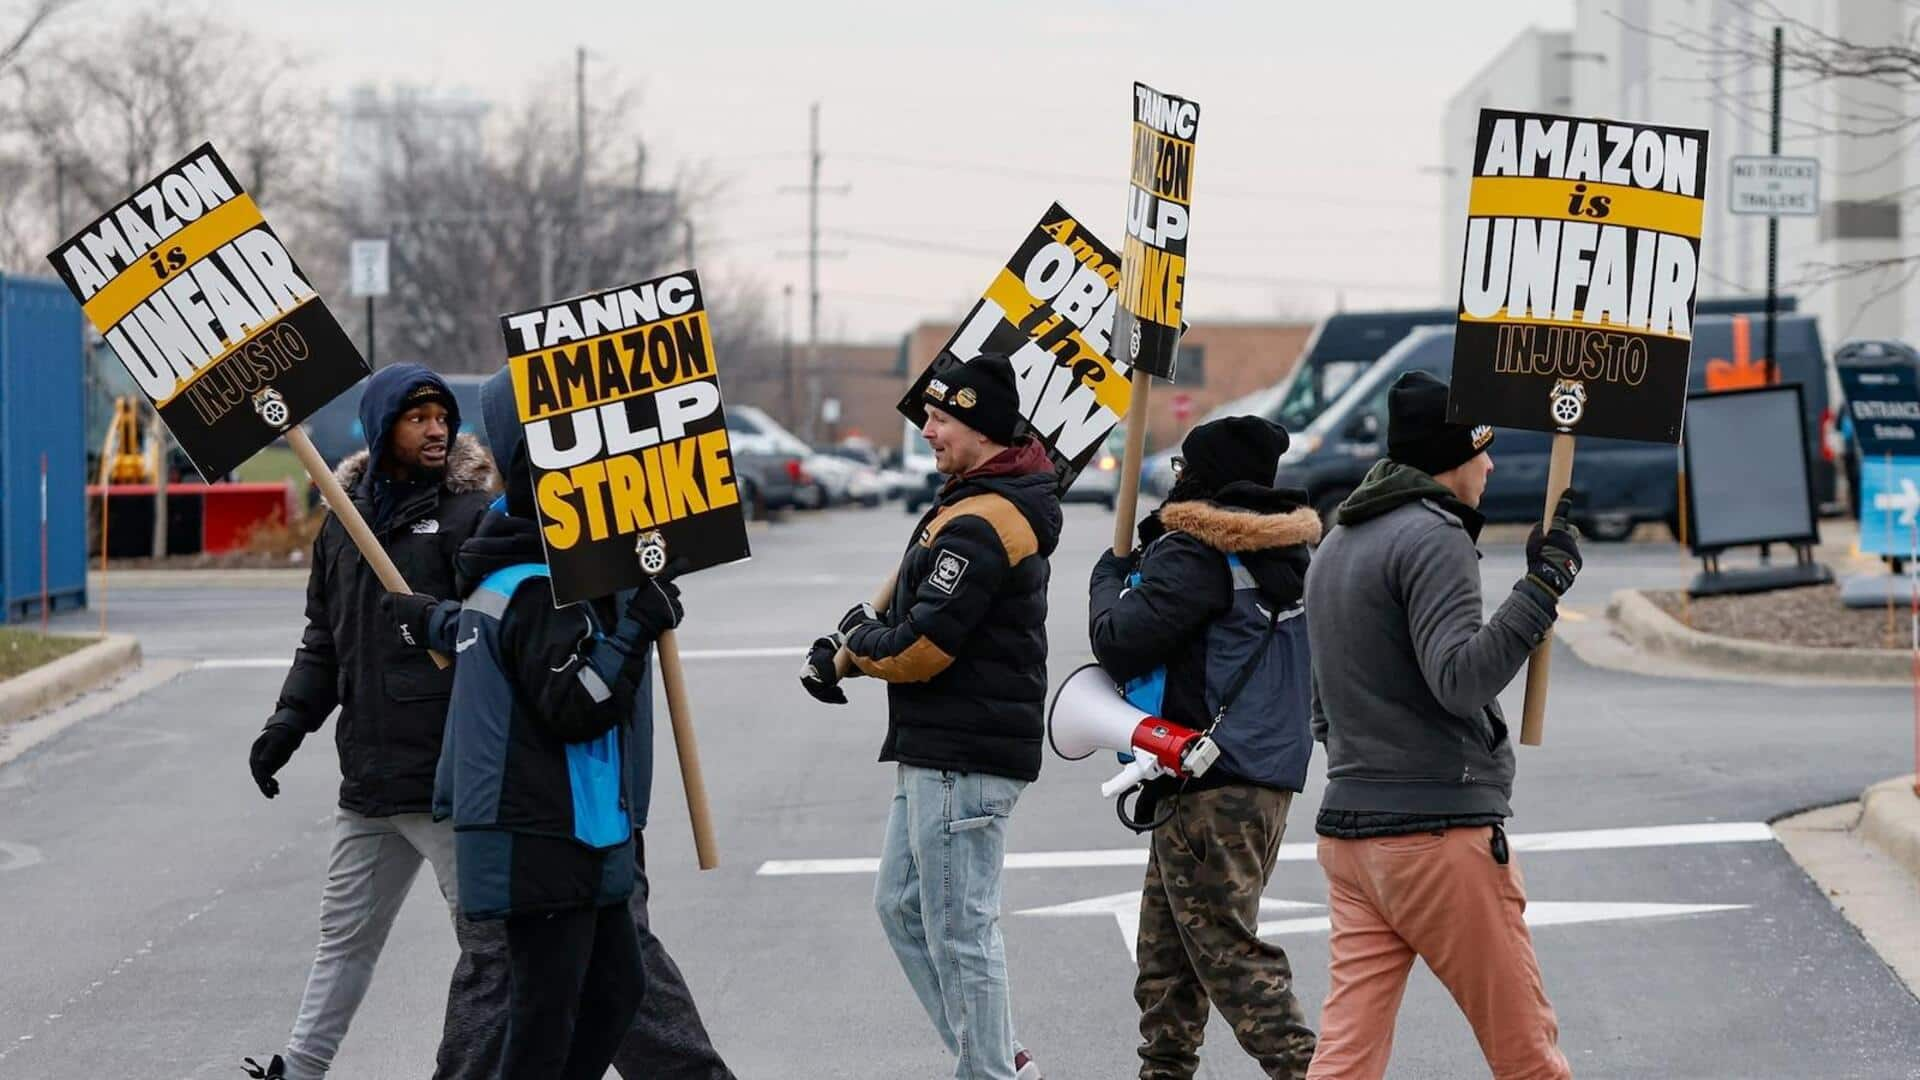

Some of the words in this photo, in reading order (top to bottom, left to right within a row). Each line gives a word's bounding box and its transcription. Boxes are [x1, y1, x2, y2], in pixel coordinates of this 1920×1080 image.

[1136, 85, 1197, 140] TANNC
[1482, 117, 1699, 196] AMAZON
[1131, 127, 1191, 202] AMAZON
[1567, 184, 1611, 218] is
[62, 153, 236, 301] AMAZON
[1040, 217, 1121, 291] Ama
[1127, 184, 1189, 250] ULP
[149, 245, 187, 280] is
[1119, 236, 1185, 330] STRIKE
[1462, 217, 1697, 339] UNFAIR
[105, 228, 314, 401] UNFAIR
[509, 276, 695, 351] TANNC
[1018, 301, 1107, 390] the
[1024, 240, 1131, 377] OBE
[186, 322, 309, 426] INJUSTO
[529, 316, 708, 416] AMAZON
[950, 297, 1120, 461] LAW
[1494, 324, 1648, 386] INJUSTO
[524, 381, 720, 470] ULP
[537, 429, 739, 550] STRIKE
